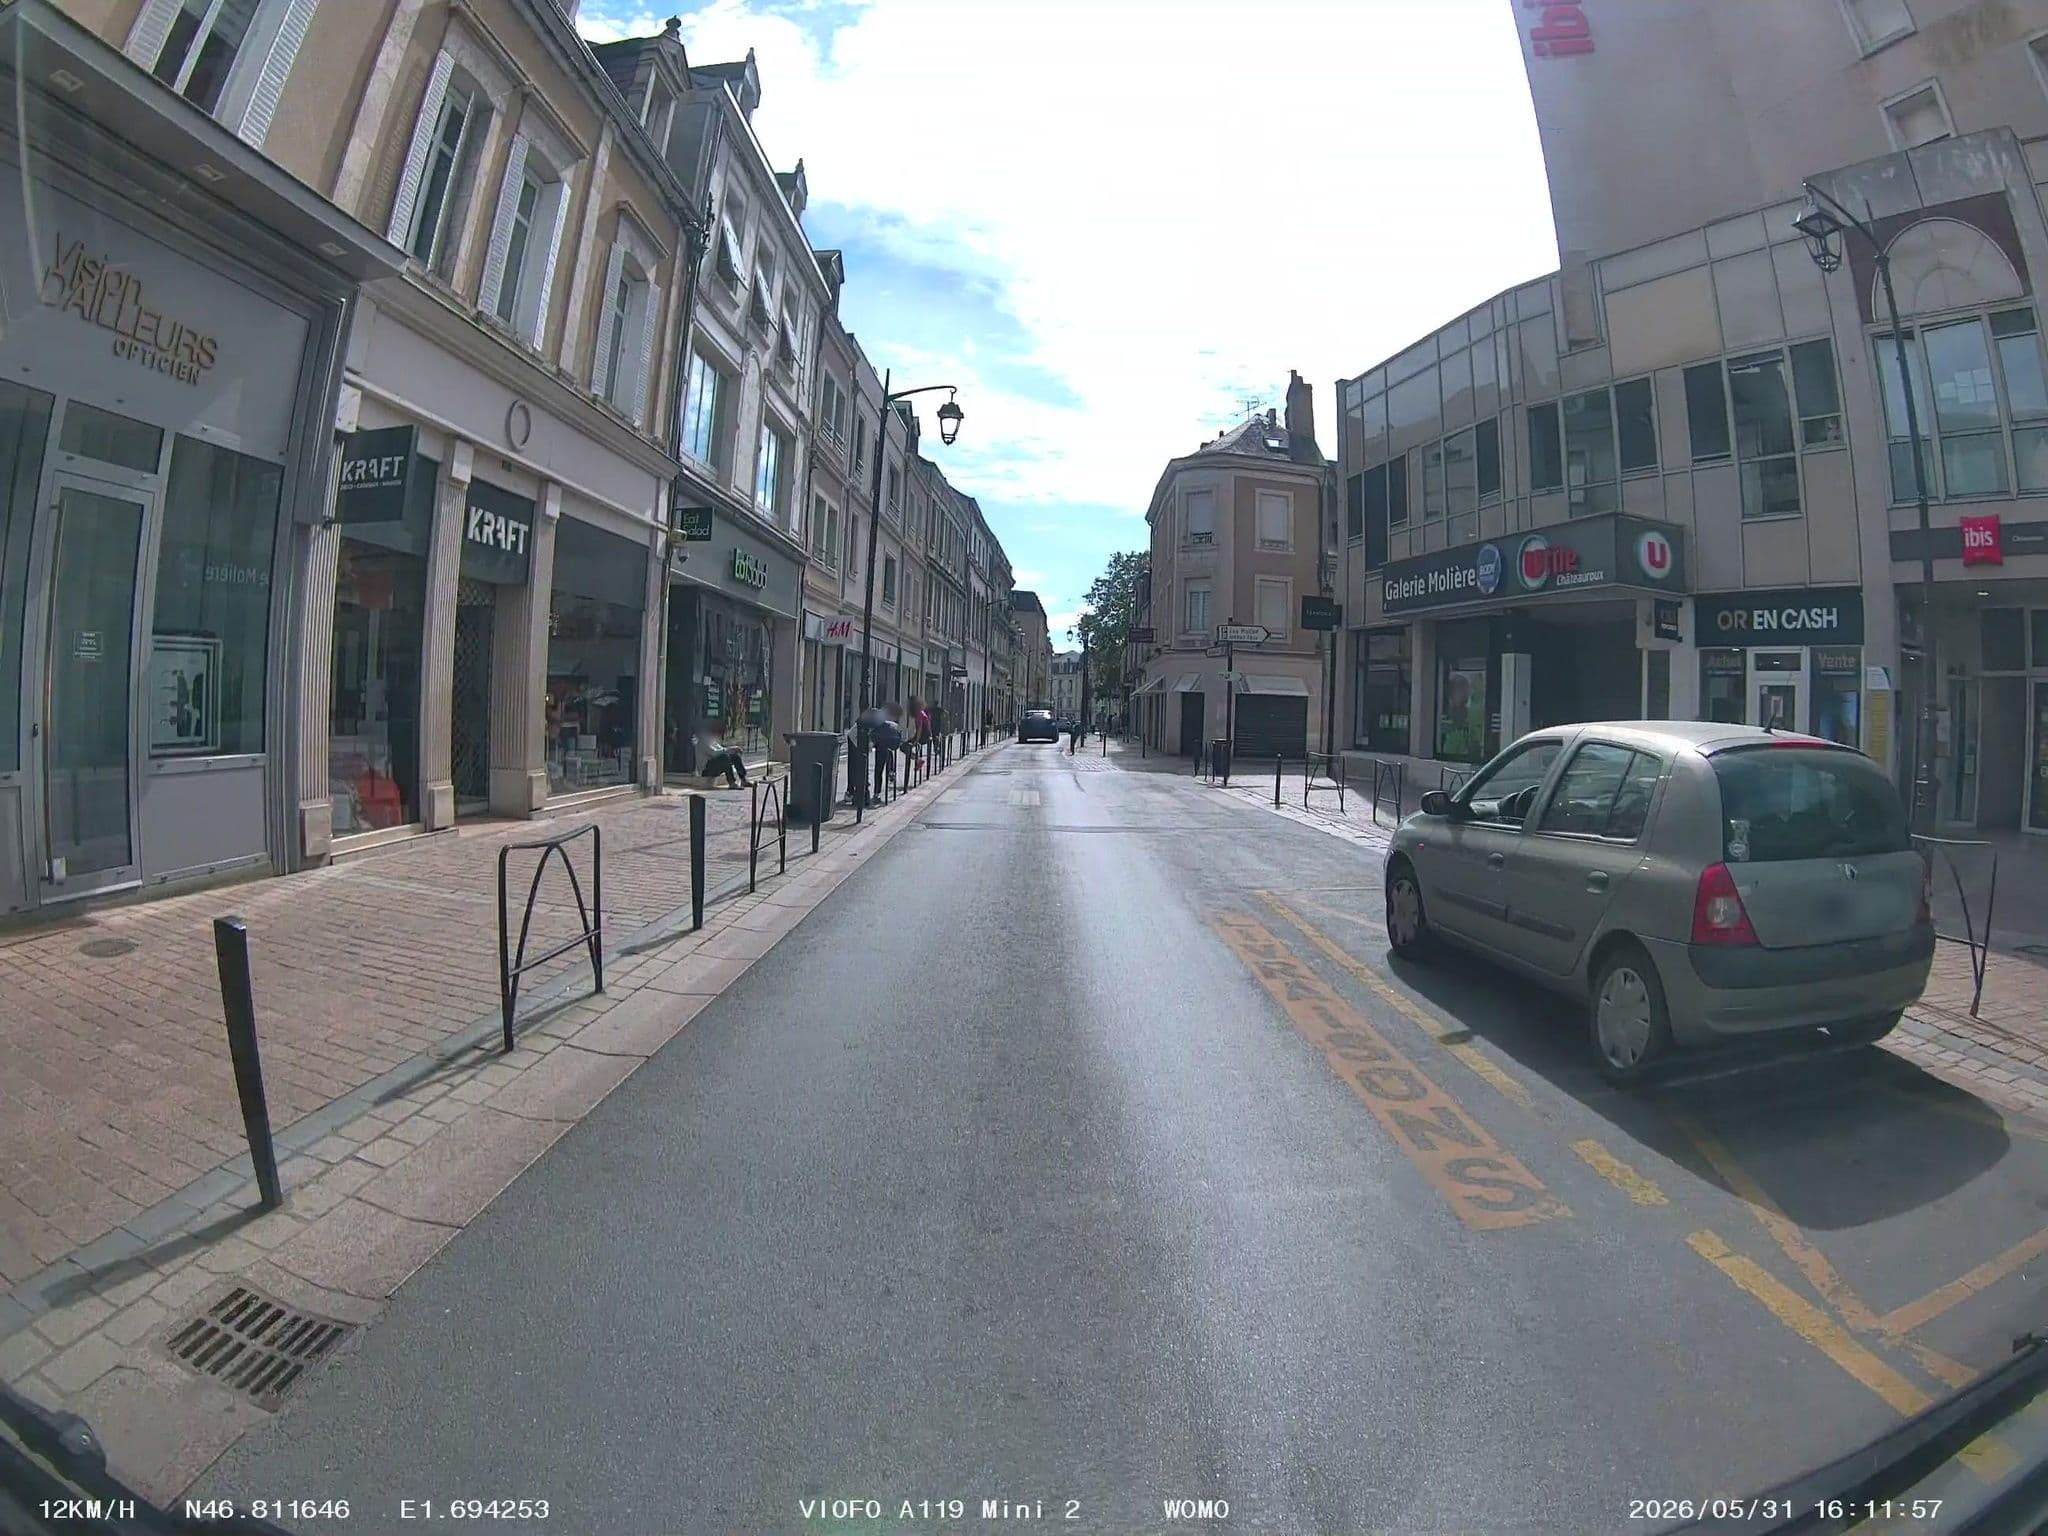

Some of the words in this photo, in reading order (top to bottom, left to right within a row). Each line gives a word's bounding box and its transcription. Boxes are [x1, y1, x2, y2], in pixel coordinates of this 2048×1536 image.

[55, 231, 141, 306] Vision
[113, 338, 200, 385] OPTICIEN
[341, 456, 404, 482] KRAFT
[467, 506, 529, 554] KRAFT
[1964, 527, 1994, 547] ibis
[1647, 541, 1667, 569] U
[1385, 575, 1426, 601] Galerie
[1428, 565, 1477, 593] Molière
[1556, 571, 1604, 586] Châteauroux
[1717, 611, 1748, 631] OR
[1753, 609, 1777, 630] EN
[1781, 607, 1838, 630] CASH
[1817, 653, 1857, 668] Vente
